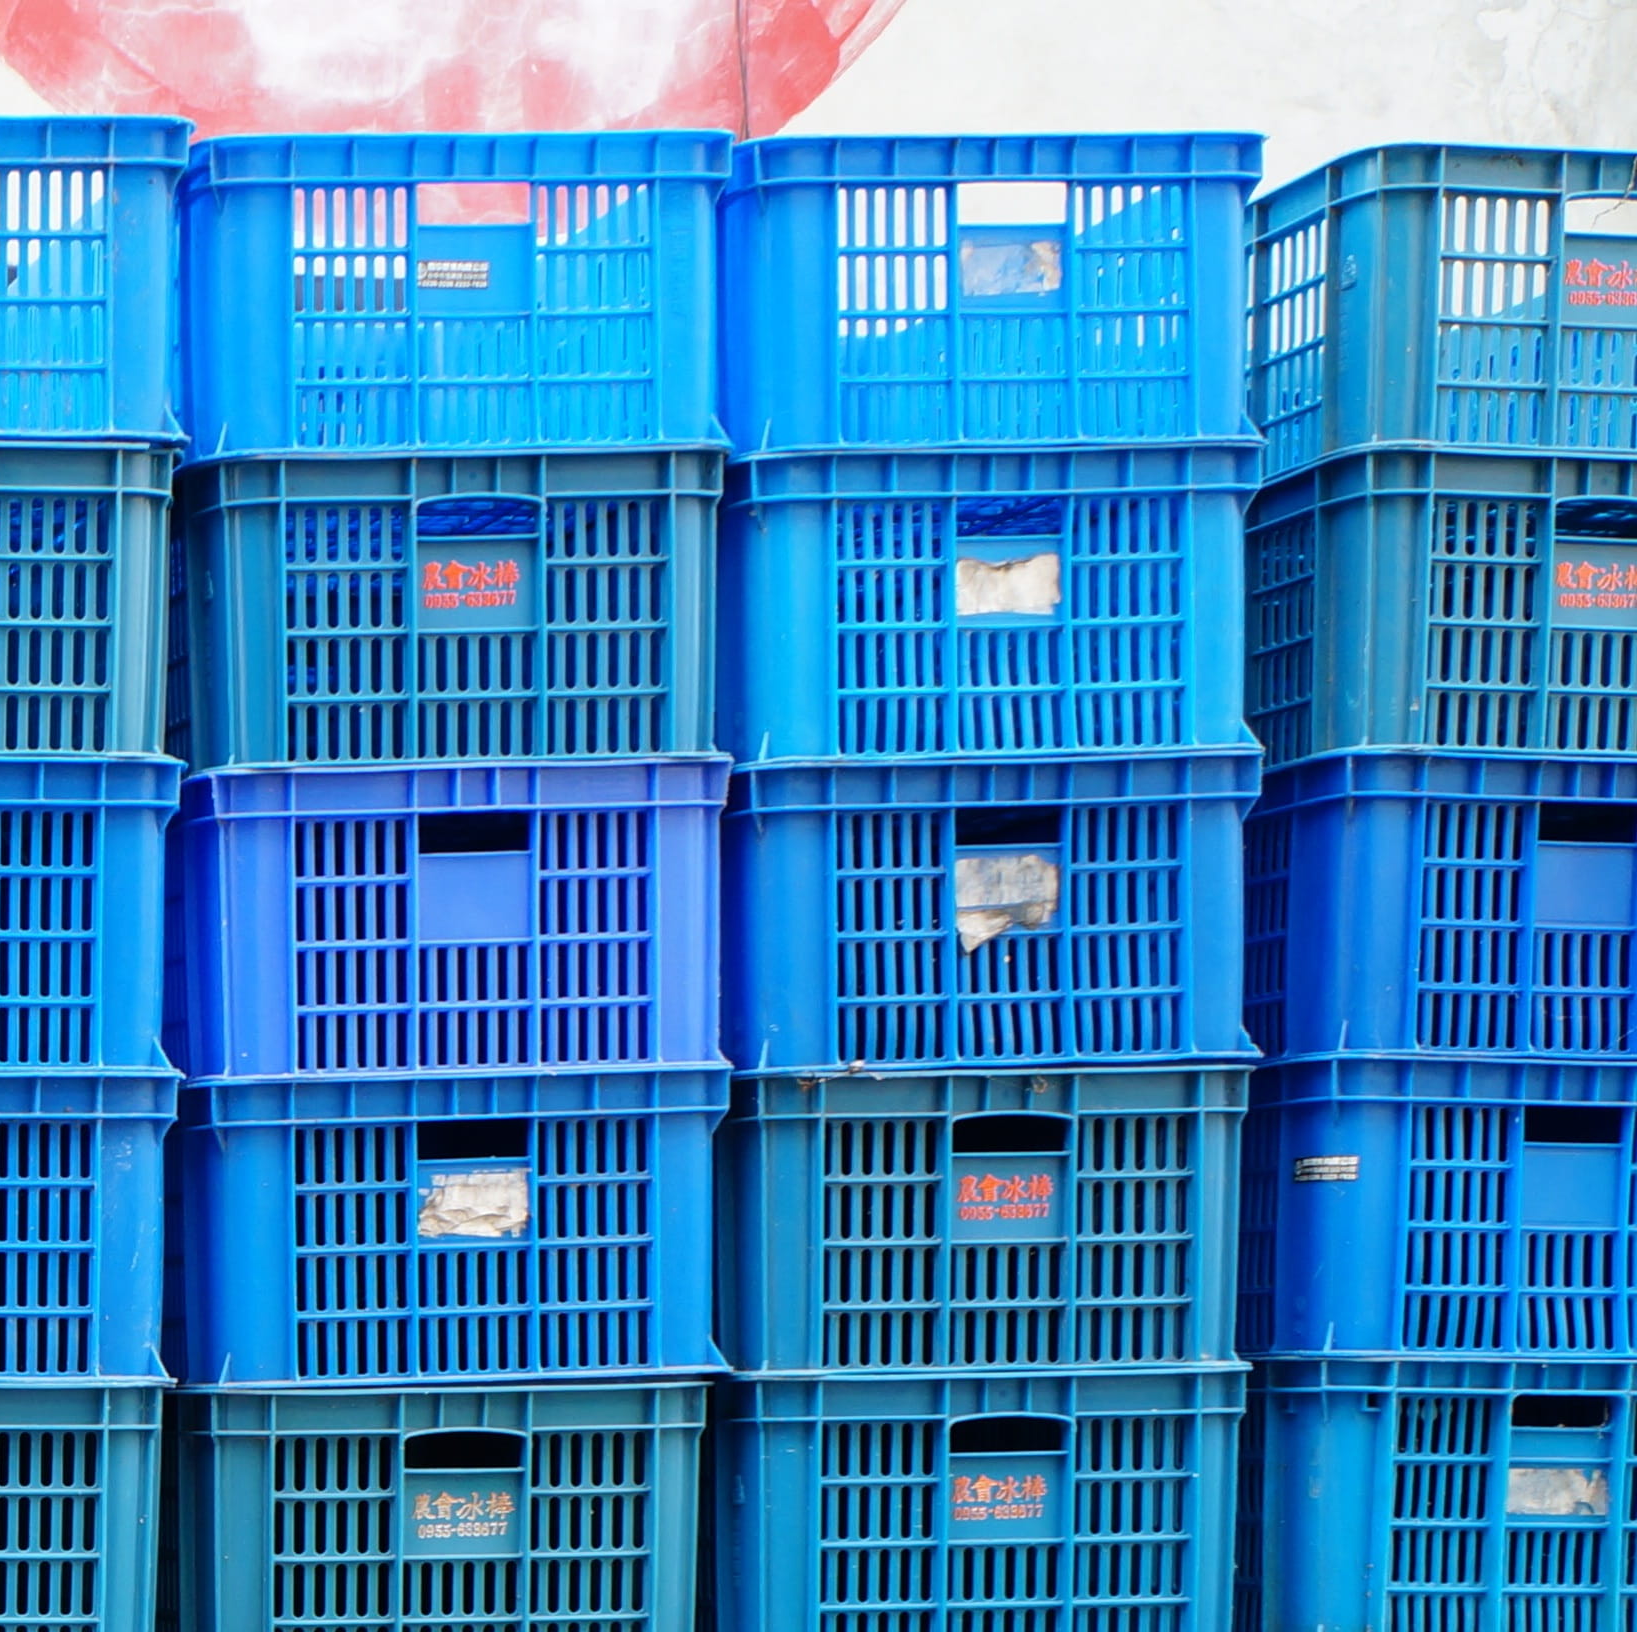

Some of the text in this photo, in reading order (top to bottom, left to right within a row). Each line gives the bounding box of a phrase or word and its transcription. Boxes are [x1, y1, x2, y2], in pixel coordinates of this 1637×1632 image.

[1565, 259, 1637, 289] 農會冰
[422, 560, 520, 589] 農會冰棒
[957, 1174, 1053, 1202] 農會冰棒
[952, 1474, 1047, 1503] 農會冰棒
[412, 1492, 515, 1520] 農會冰棒
